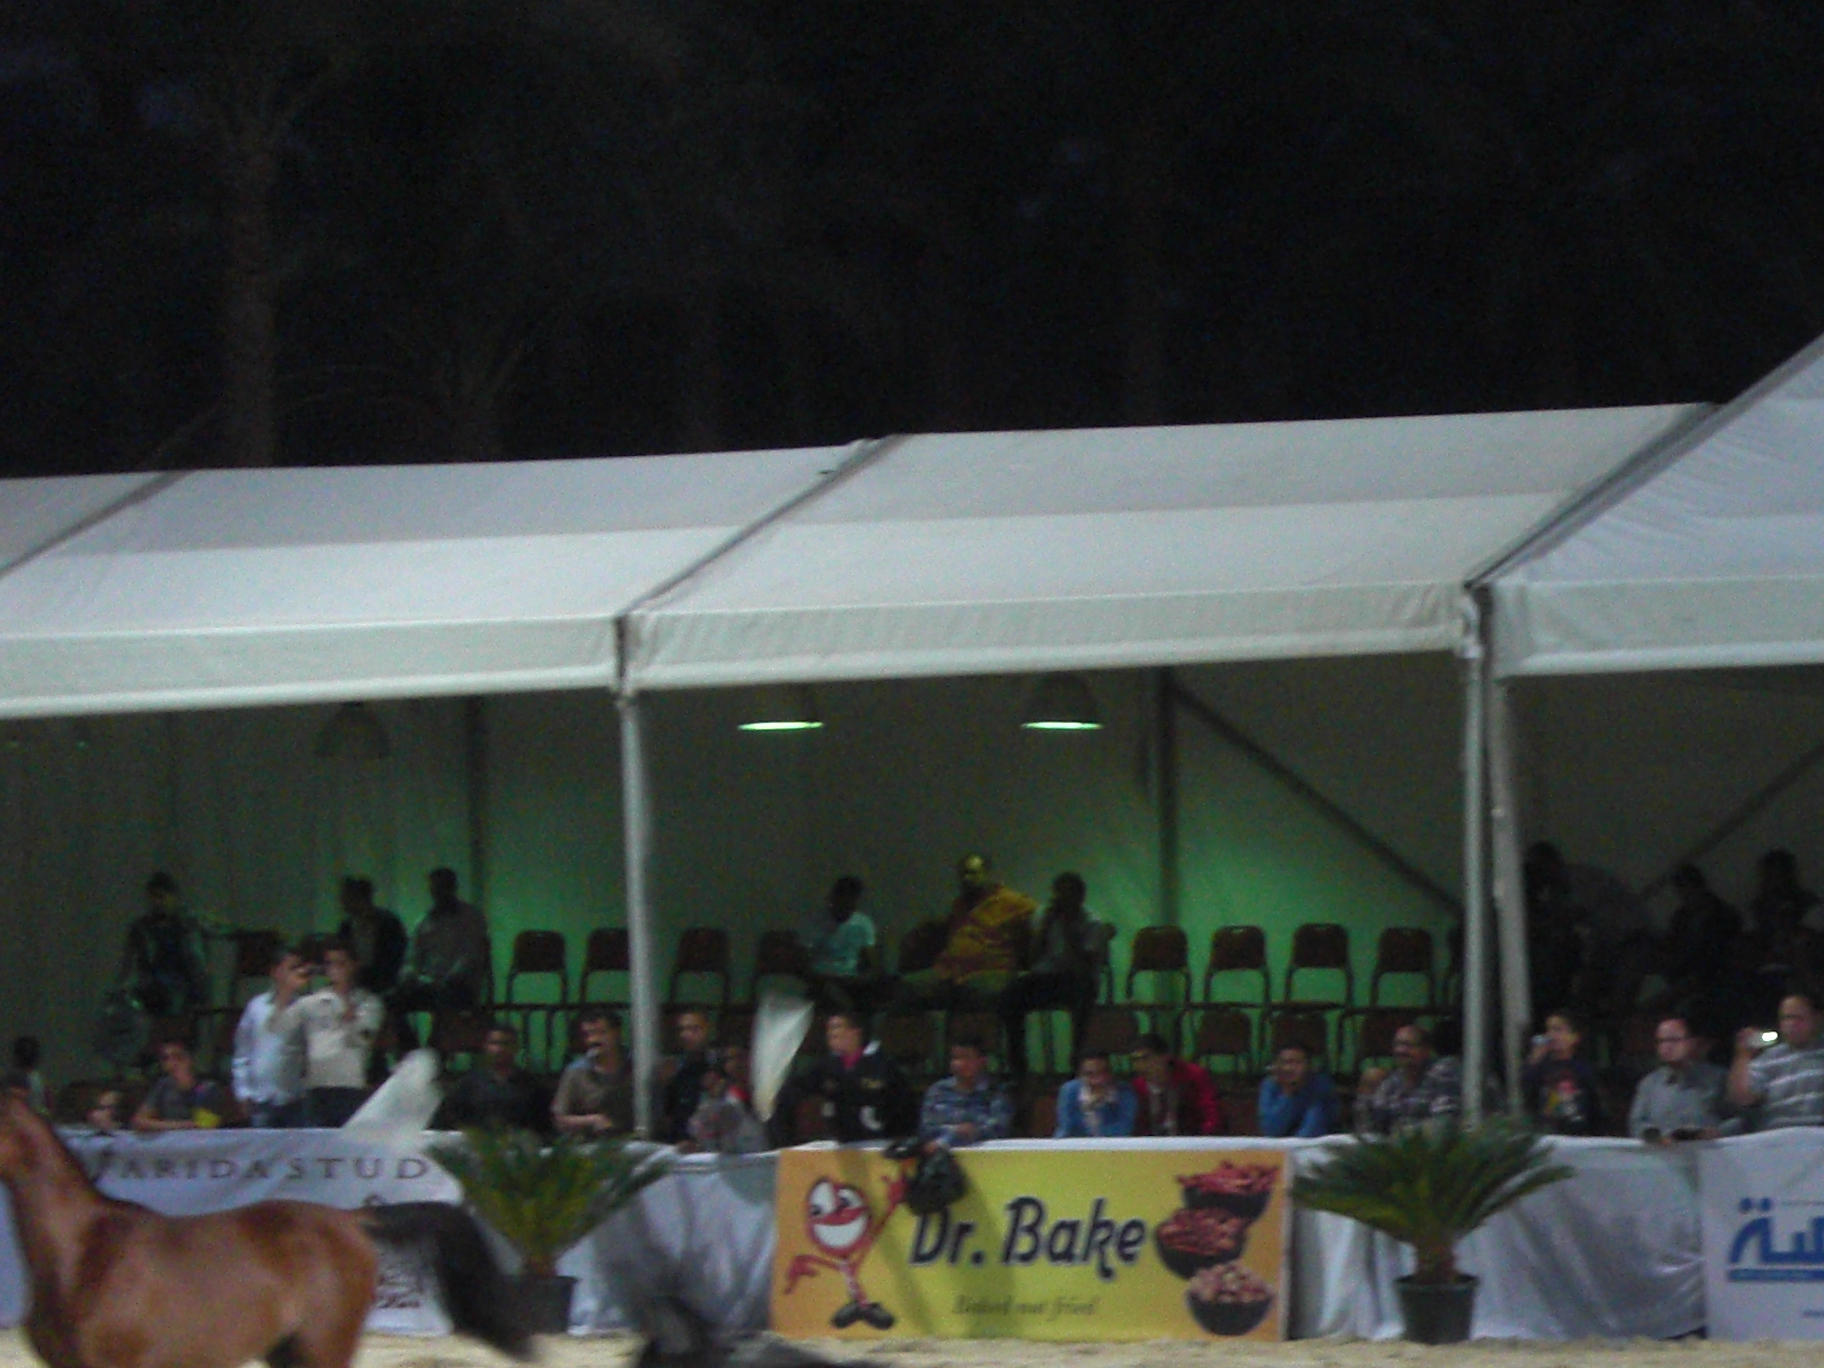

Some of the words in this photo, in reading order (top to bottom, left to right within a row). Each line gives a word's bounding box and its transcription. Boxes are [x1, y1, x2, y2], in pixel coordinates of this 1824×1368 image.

[286, 1157, 429, 1181] STUD
[909, 1202, 984, 1265] Dr.
[1002, 1196, 1146, 1280] Bake
